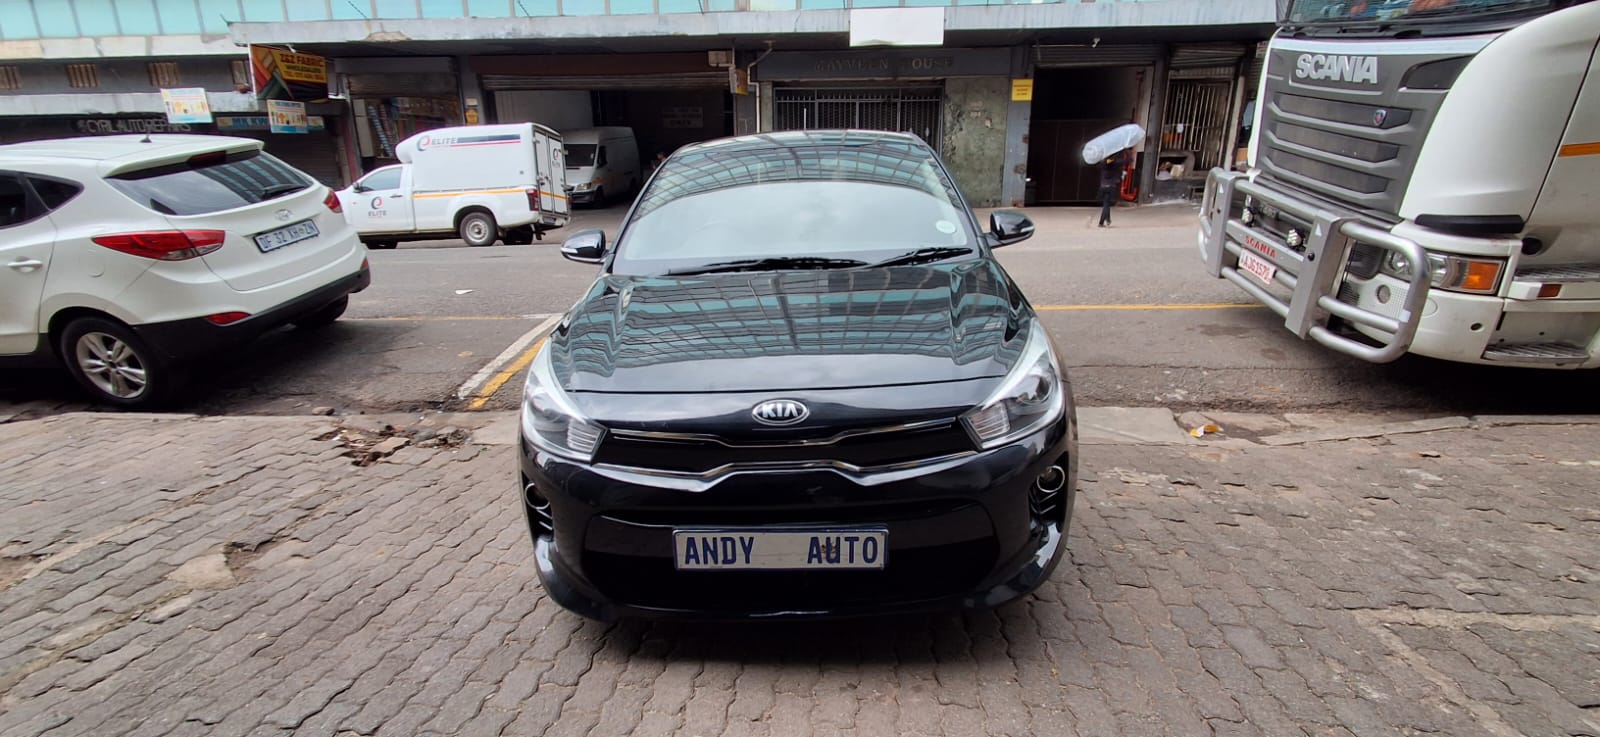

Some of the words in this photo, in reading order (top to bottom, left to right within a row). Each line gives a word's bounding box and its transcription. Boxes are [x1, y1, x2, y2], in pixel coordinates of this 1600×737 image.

[1296, 53, 1378, 84] SCANIA
[117, 119, 145, 132] AUTO
[431, 137, 457, 145] ELITE
[1244, 235, 1277, 258] SCANIA
[762, 404, 799, 418] KIA
[684, 536, 754, 565] ANDY
[807, 536, 878, 564] AUTO
